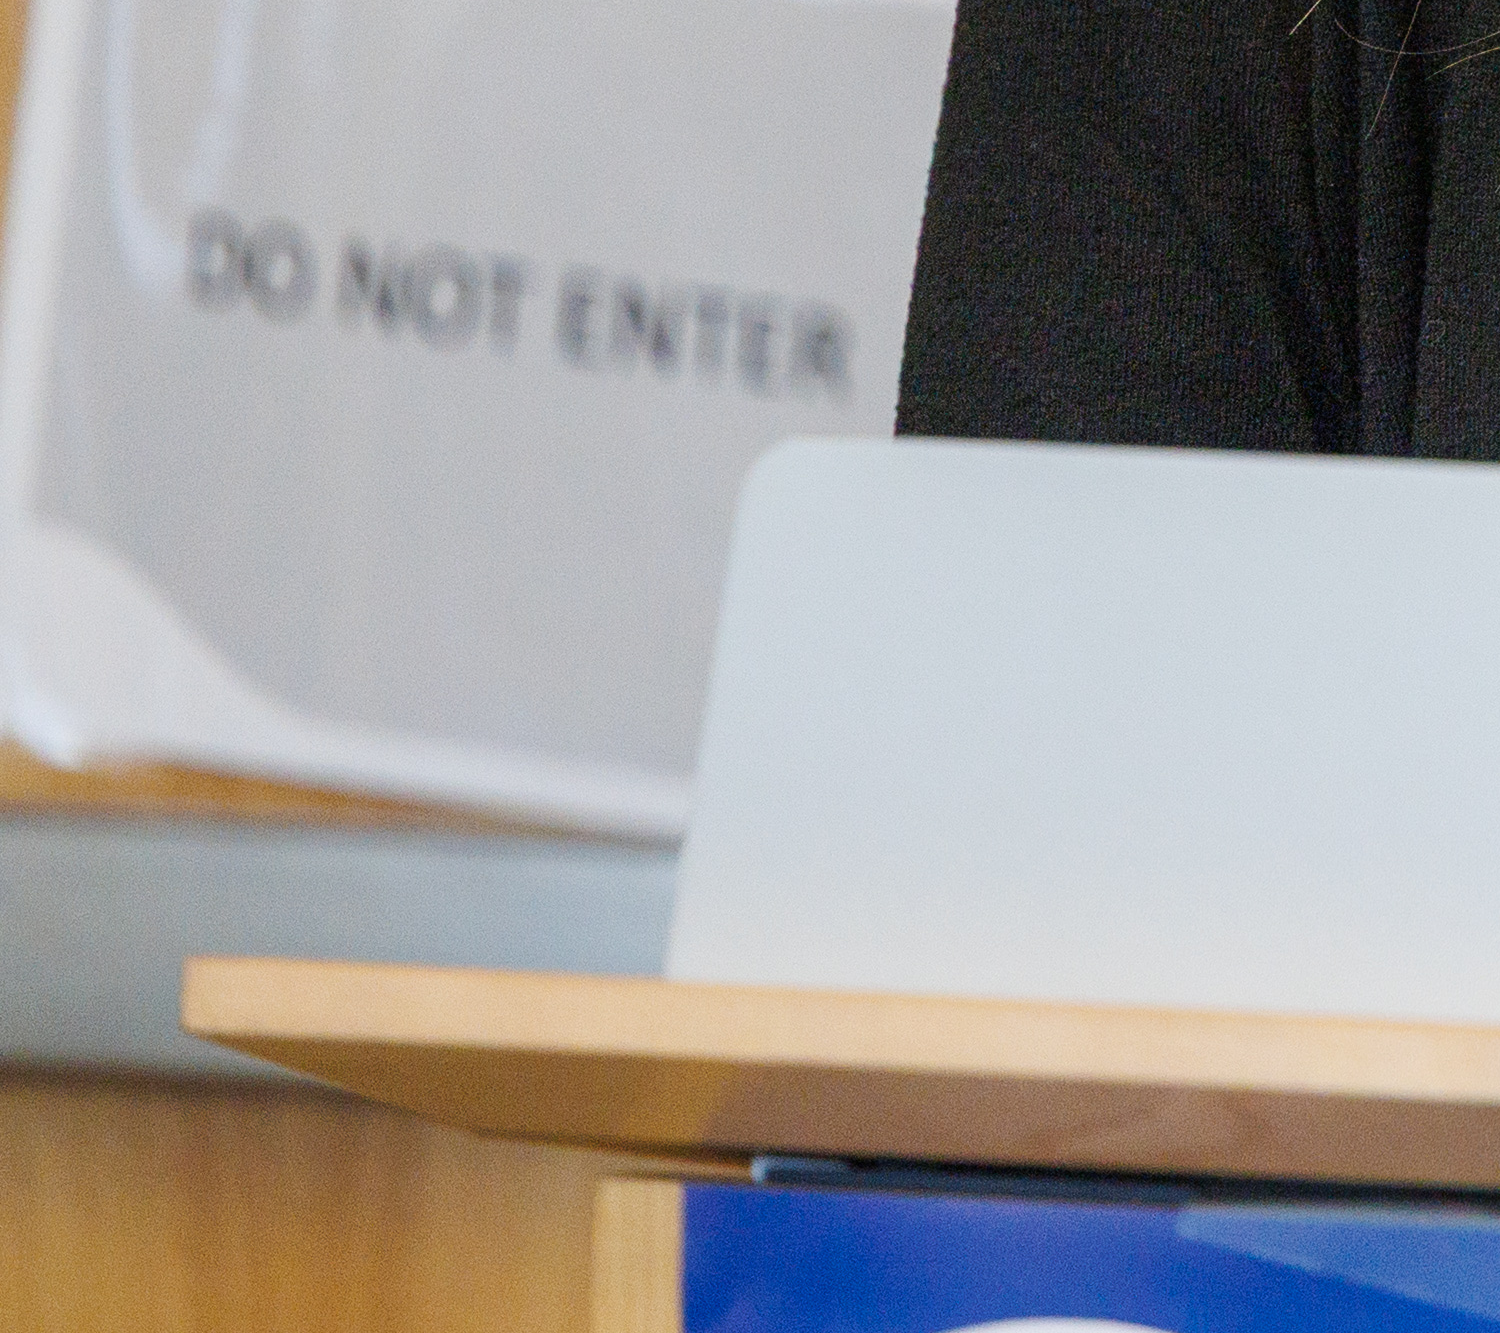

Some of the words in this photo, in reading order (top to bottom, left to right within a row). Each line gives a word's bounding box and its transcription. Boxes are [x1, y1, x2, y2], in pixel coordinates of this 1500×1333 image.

[188, 206, 317, 323] DO
[340, 233, 531, 353] NOT
[560, 263, 852, 401] ENTER
